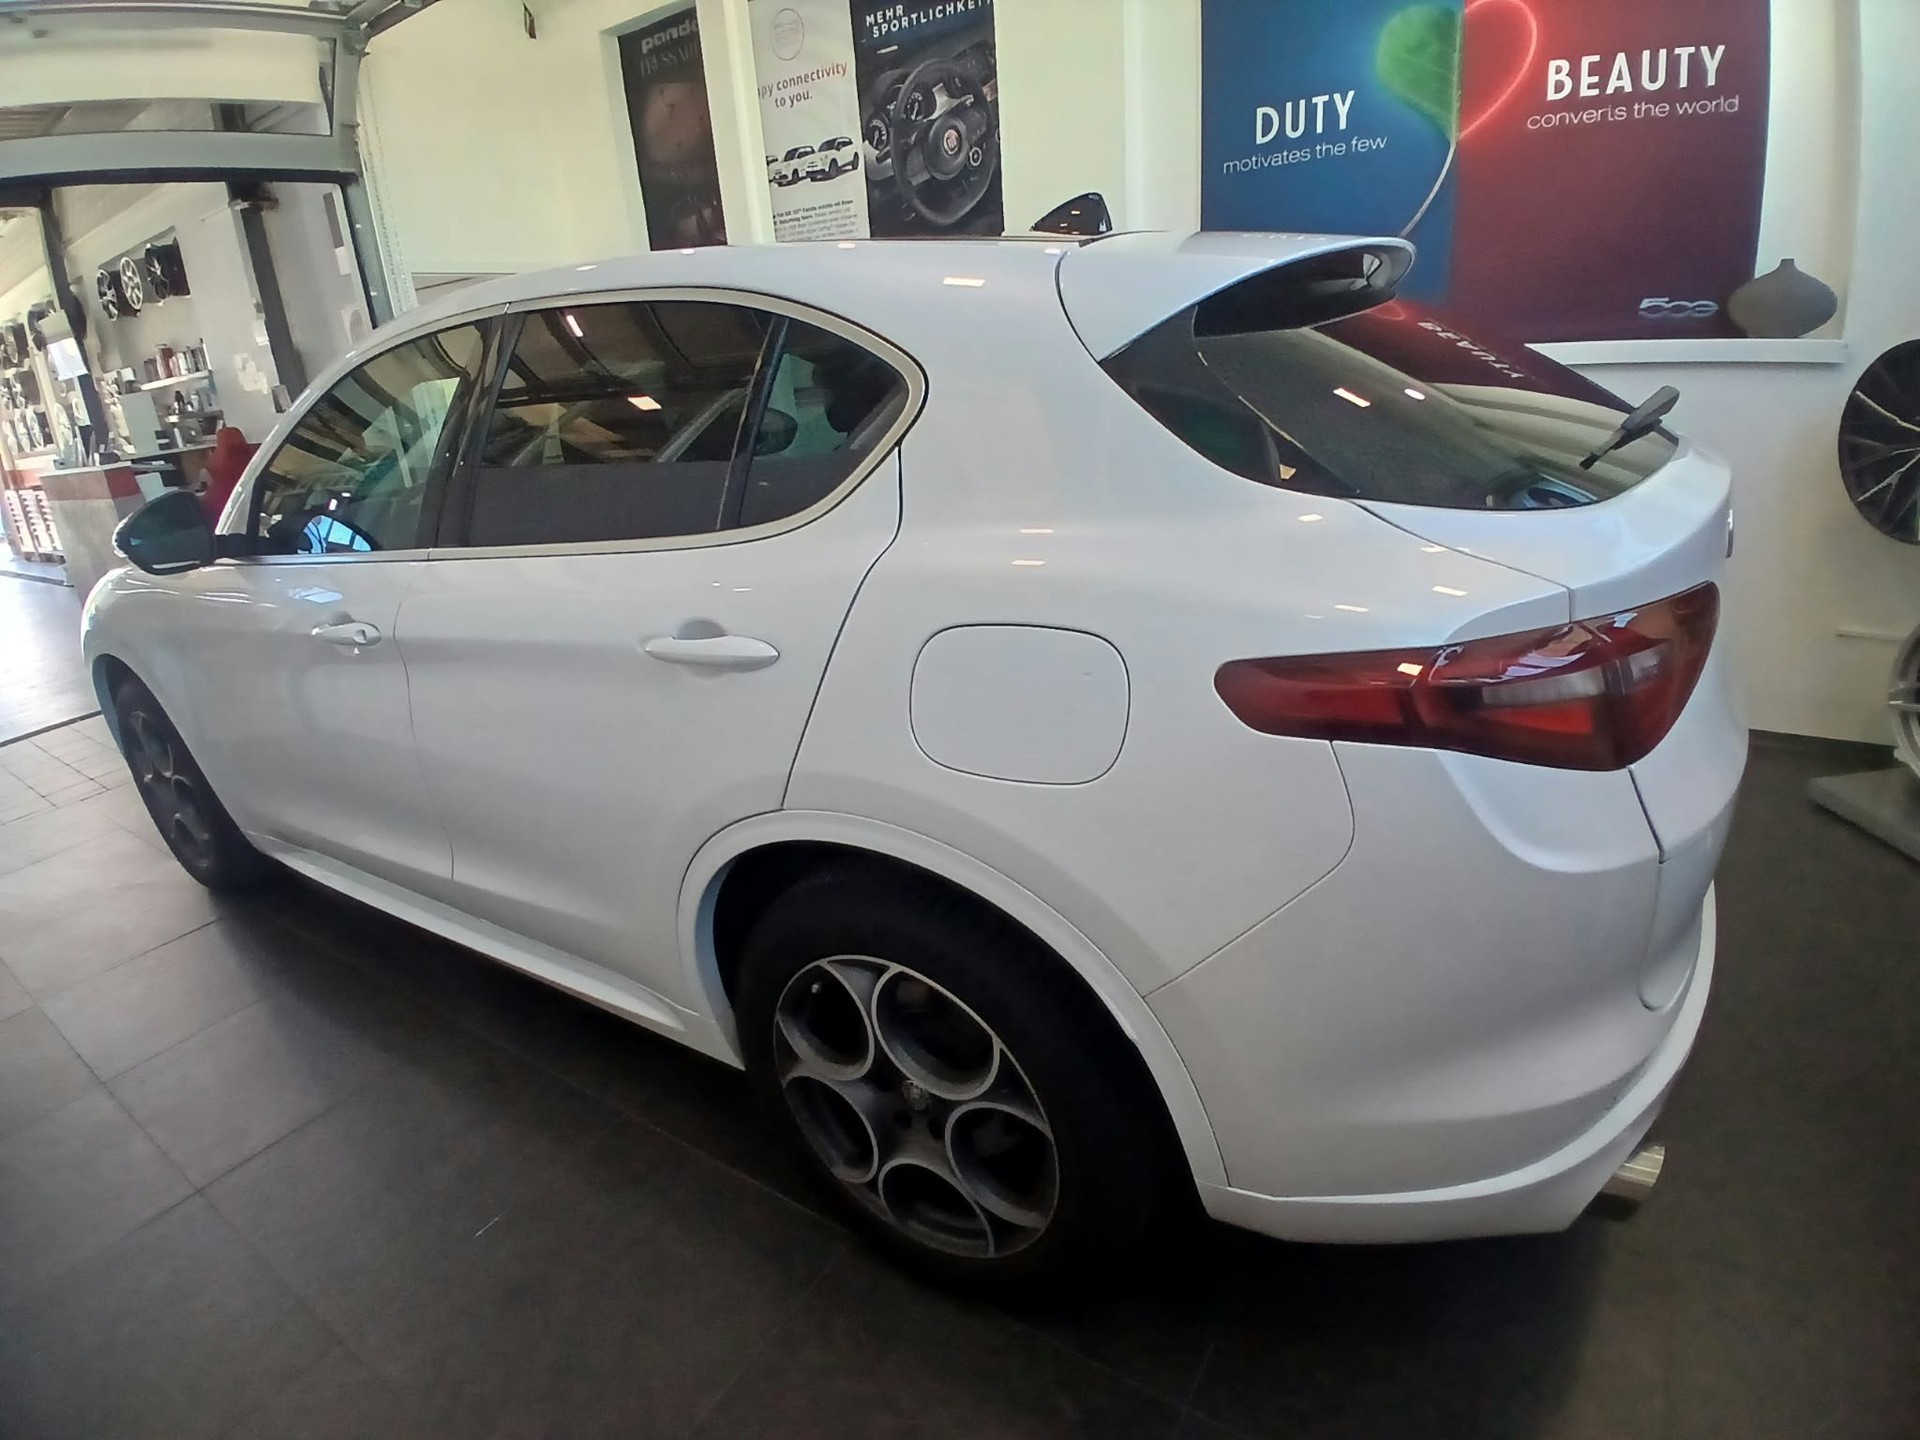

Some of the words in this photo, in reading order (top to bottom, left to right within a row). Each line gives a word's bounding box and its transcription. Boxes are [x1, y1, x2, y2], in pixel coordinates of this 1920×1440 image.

[865, 4, 904, 27] MEHR
[776, 62, 848, 91] connectivity
[1546, 45, 1725, 101] BEAUTY
[774, 96, 787, 108] to
[788, 90, 813, 108] you.
[1633, 101, 1669, 119] the
[1676, 94, 1739, 115] world
[1255, 90, 1355, 145] DUTY
[1223, 148, 1311, 174] motivates
[1315, 142, 1346, 159] the
[1351, 136, 1388, 153] few
